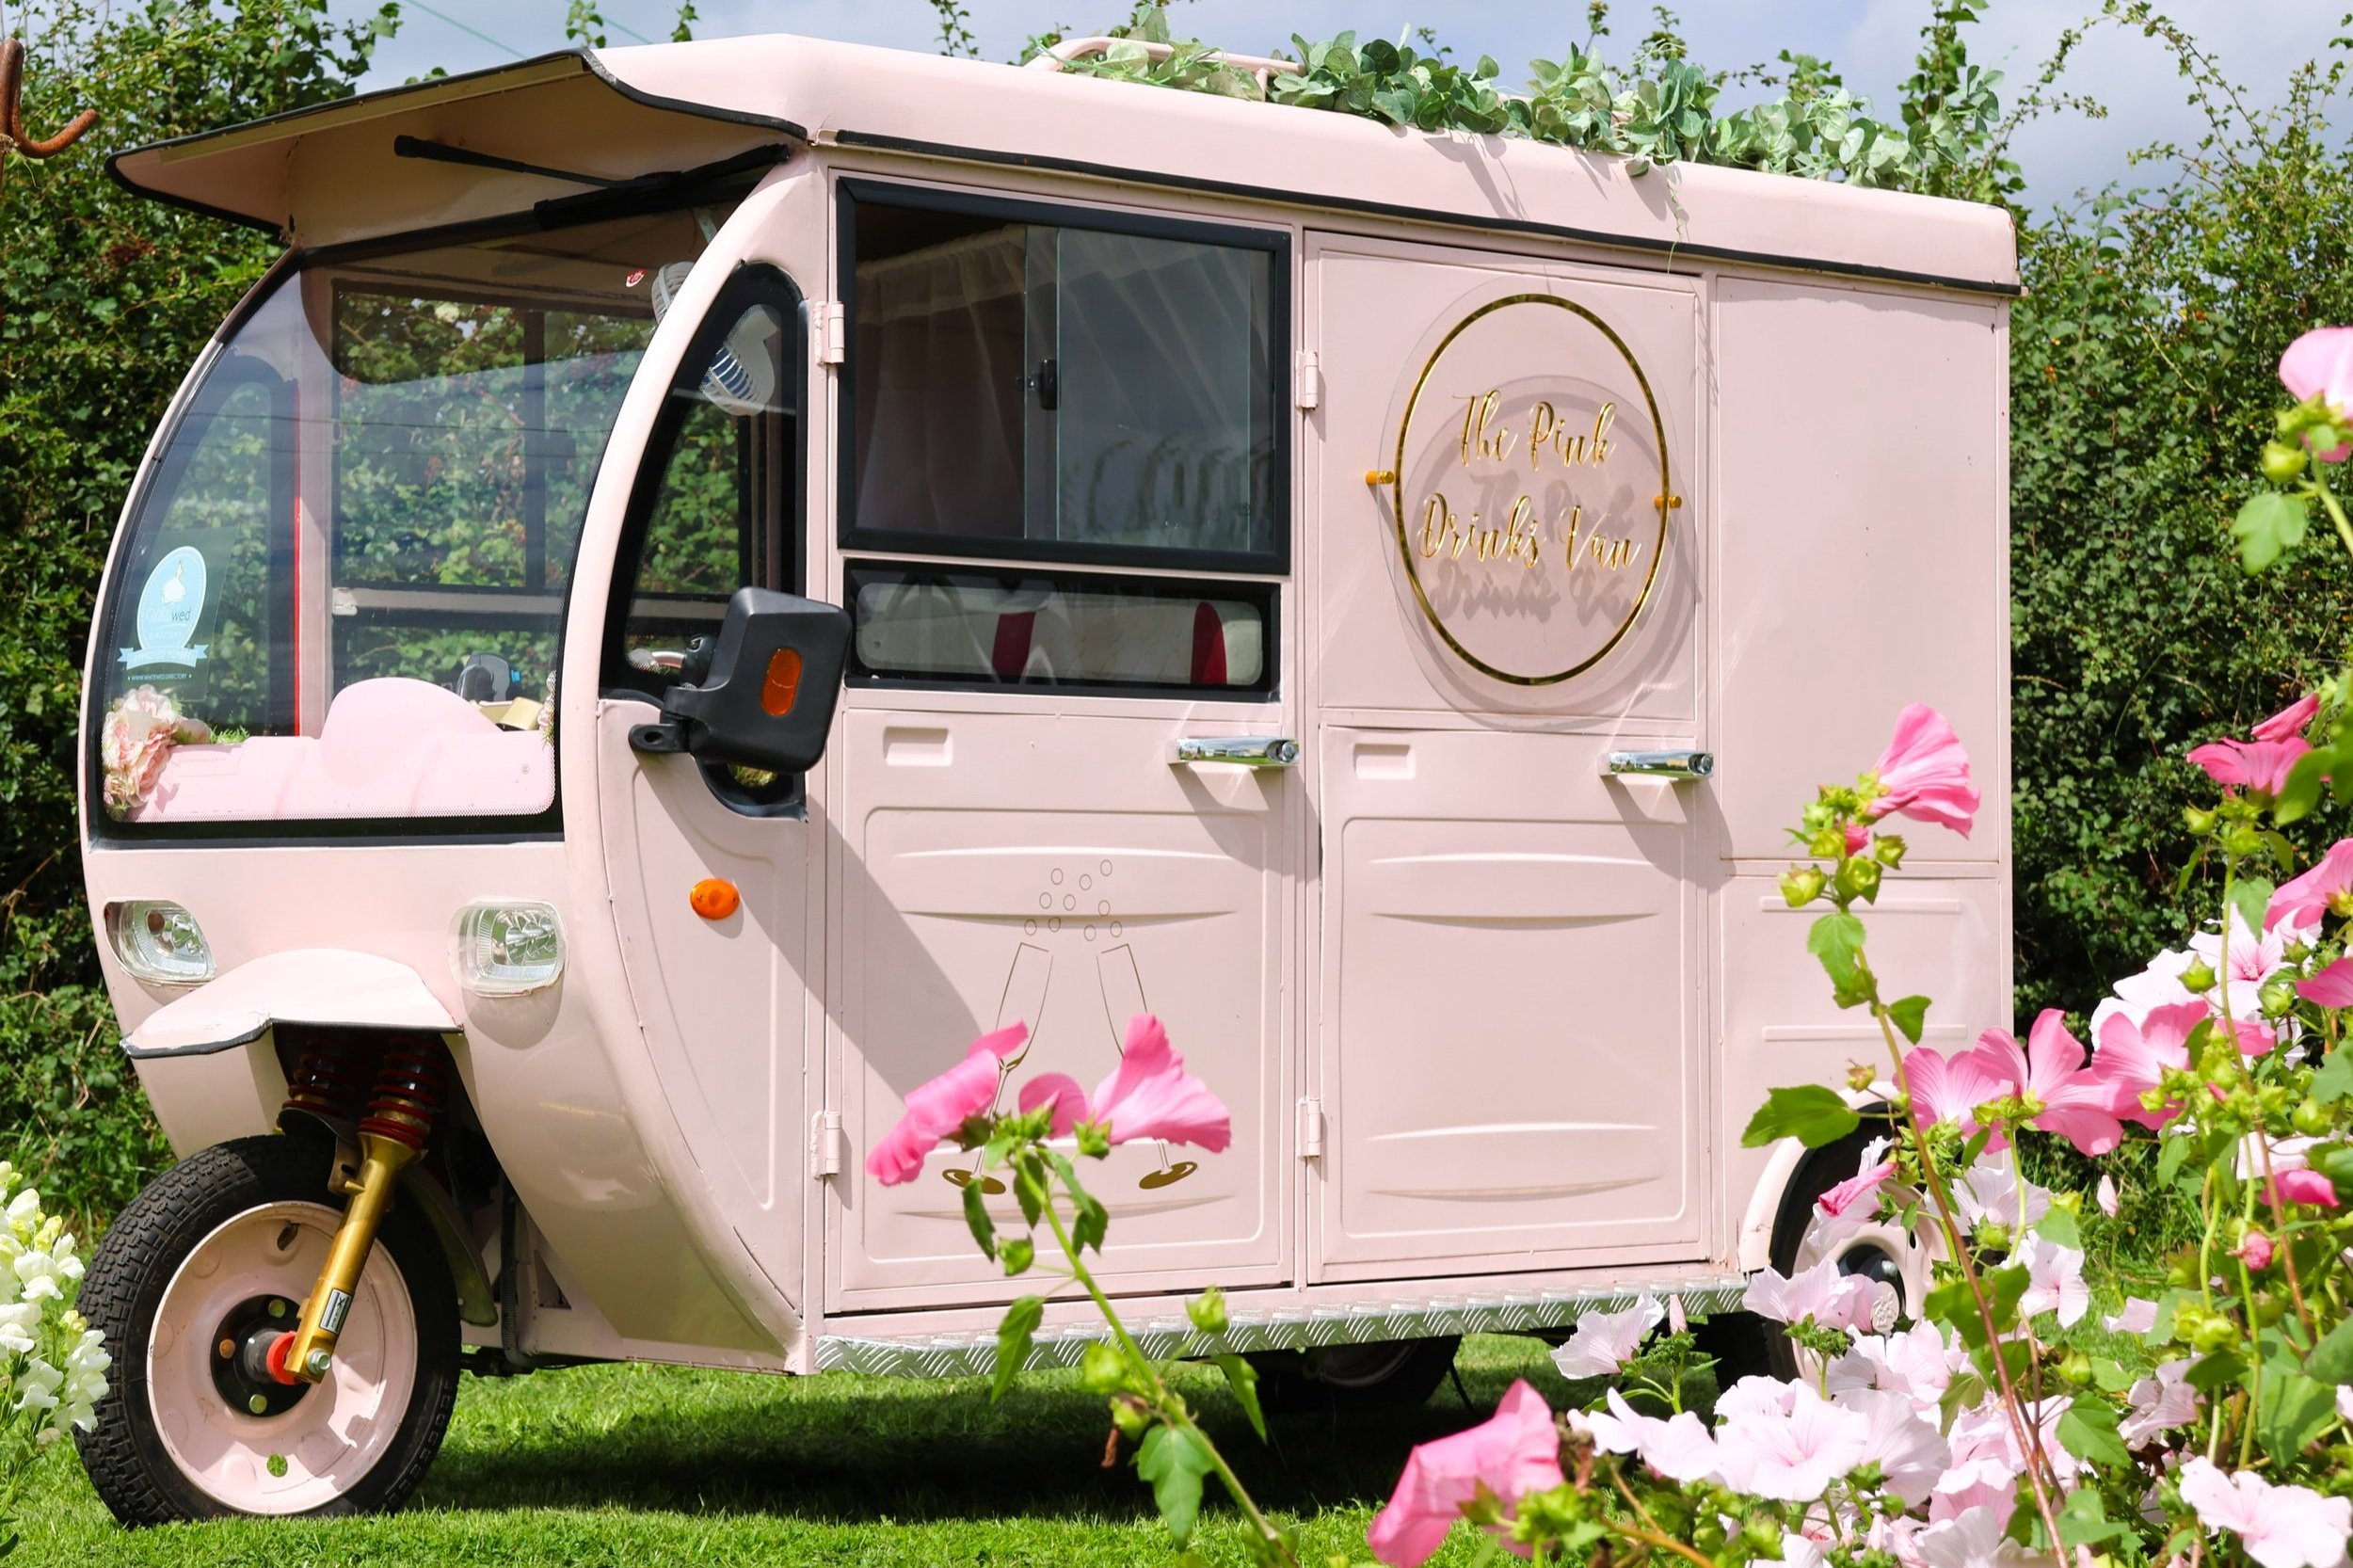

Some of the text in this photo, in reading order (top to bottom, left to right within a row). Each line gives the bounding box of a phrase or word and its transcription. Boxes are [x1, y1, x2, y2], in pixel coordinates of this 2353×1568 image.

[1452, 390, 1617, 471] The Pink
[1417, 492, 1642, 571] Drinks Van
